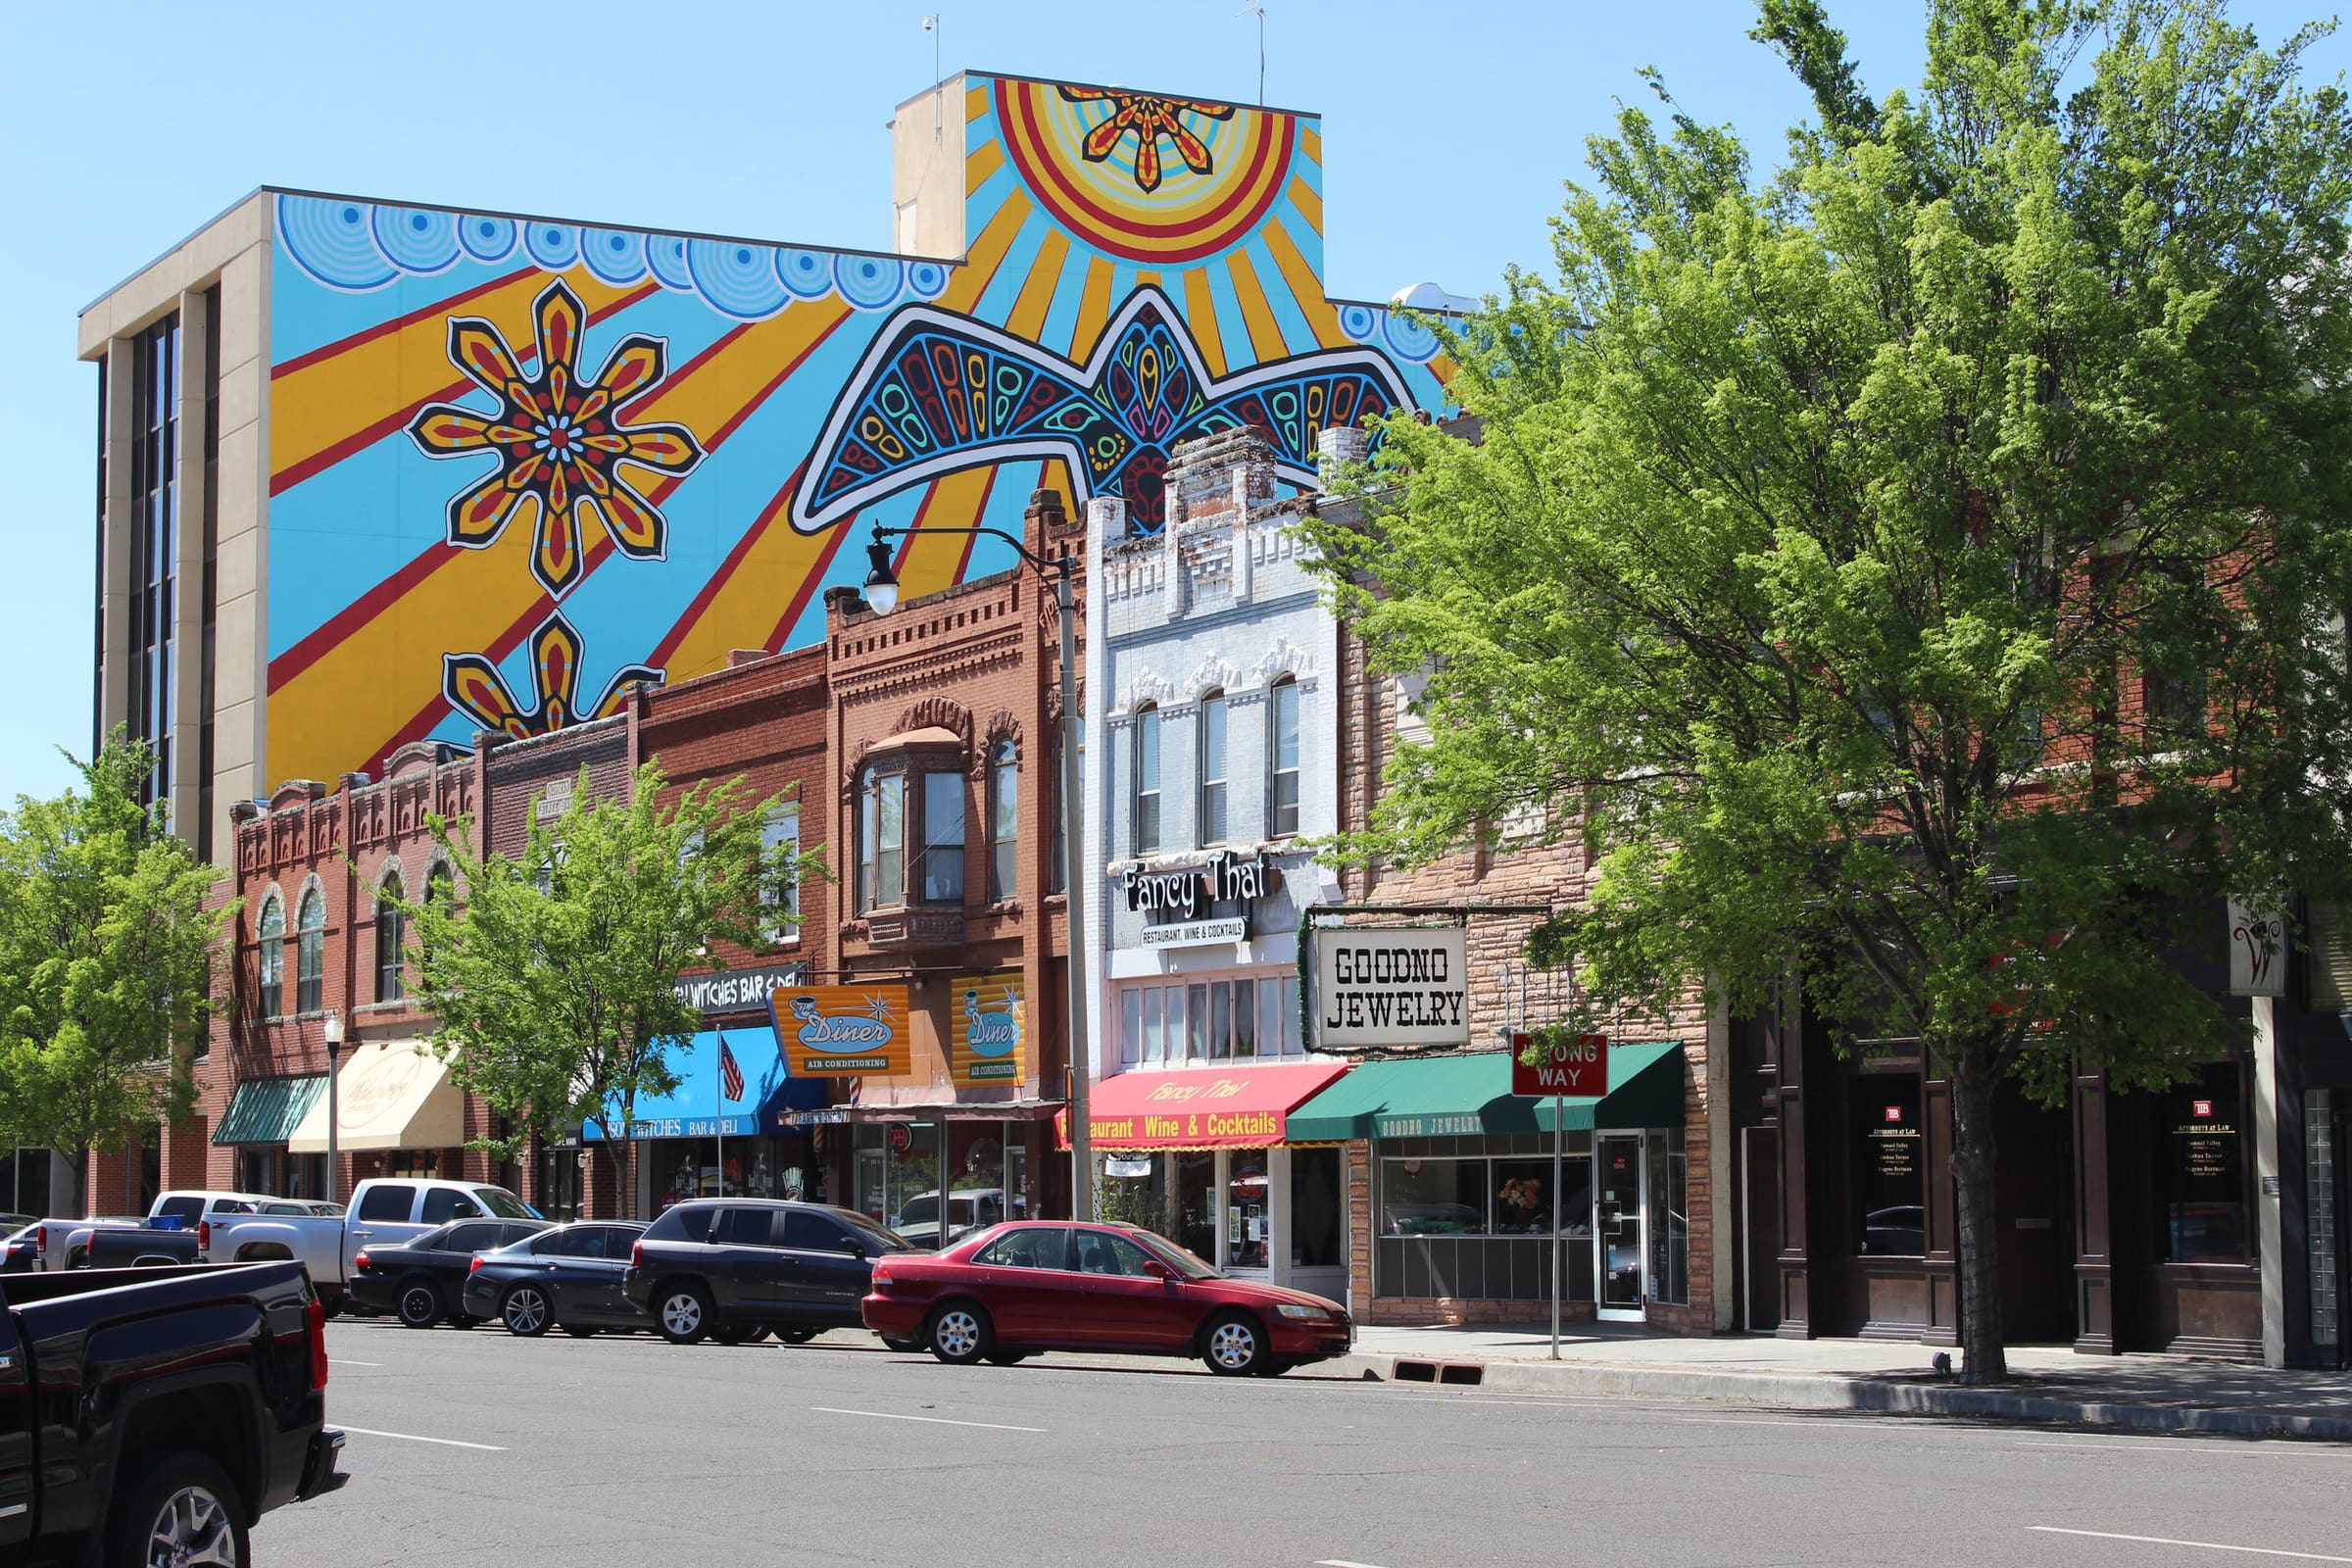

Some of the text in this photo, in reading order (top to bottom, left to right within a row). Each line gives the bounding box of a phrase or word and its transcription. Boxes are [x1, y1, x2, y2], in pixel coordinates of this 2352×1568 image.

[1121, 851, 1265, 919] Fancy That
[1143, 922, 1243, 944] RESTAURANT, WINE & COCKTAILS
[1335, 948, 1448, 984] GOODNO
[690, 978, 738, 1007] WITCHES
[740, 975, 764, 1004] BAR
[1327, 991, 1463, 1028] JEWELRY
[805, 1012, 887, 1043] Diner
[970, 1010, 1017, 1045] Diner
[808, 1057, 886, 1069] AIR CONDITIONING
[1524, 1044, 1597, 1063] ONG
[971, 1064, 1016, 1076] AIR CONDITIONING
[1539, 1068, 1581, 1087] WAY
[1145, 1082, 1203, 1104] Fancy
[689, 1122, 706, 1136] BAR
[710, 1123, 716, 1135] &
[1061, 1110, 1276, 1139] Raurant Wine & Cocktails
[1383, 1115, 1481, 1137] GOODNO JEWELRY
